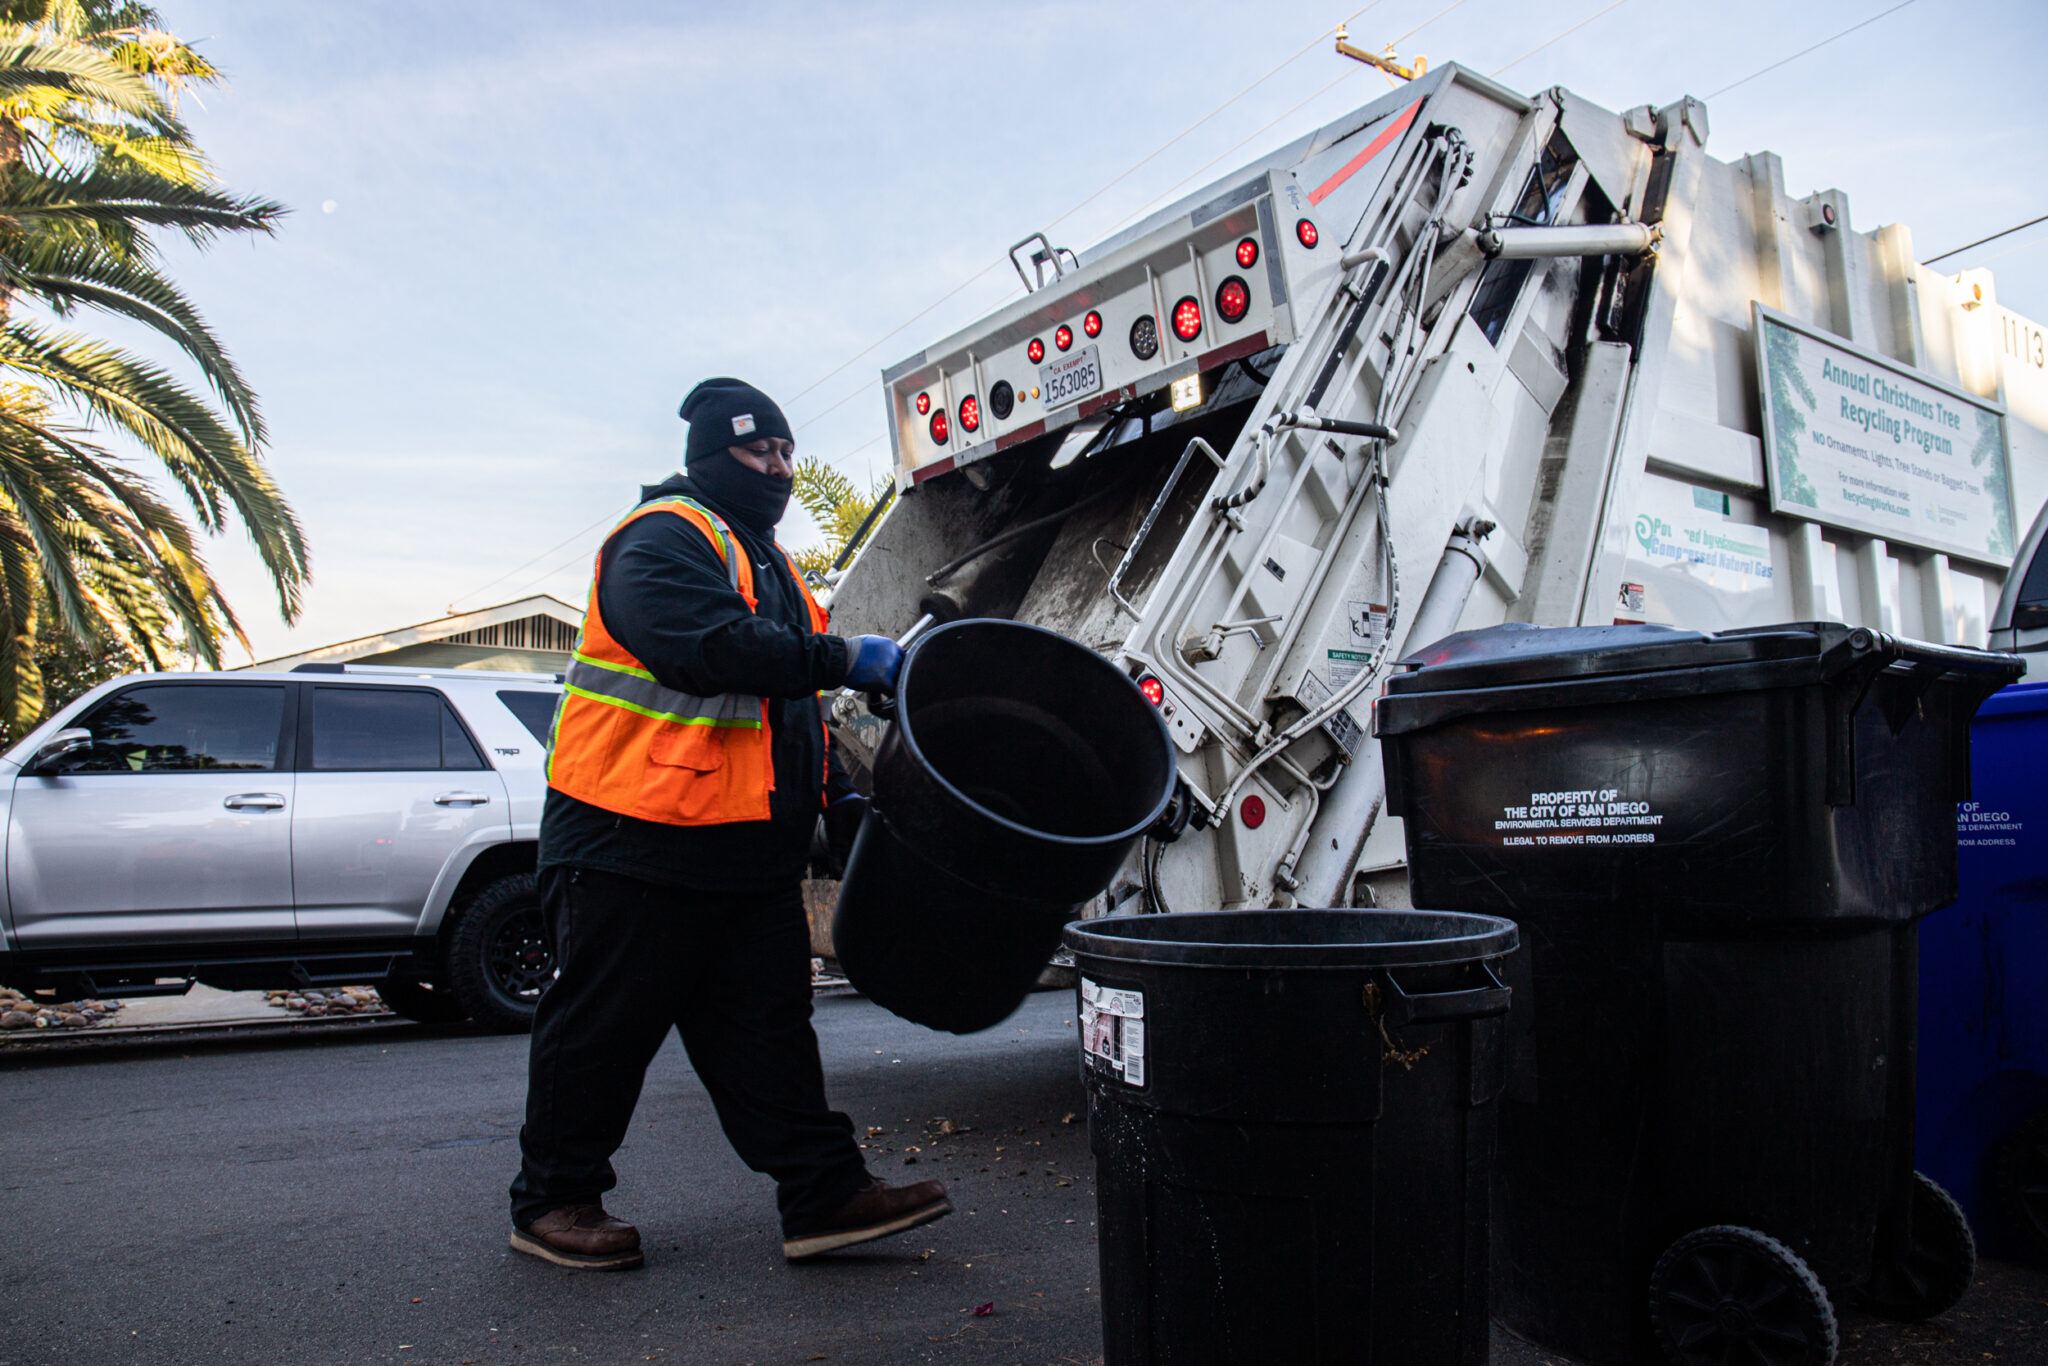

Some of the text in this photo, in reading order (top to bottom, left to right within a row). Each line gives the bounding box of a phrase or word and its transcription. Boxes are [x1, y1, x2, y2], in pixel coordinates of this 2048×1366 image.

[1053, 356, 1084, 375] CA EXEMPT
[1045, 363, 1095, 403] 1563085
[1822, 357, 1961, 431] Annual Christmas Tree
[1840, 395, 1953, 455] Recycling Program
[1812, 430, 1826, 445] NO
[1827, 435, 1871, 462] Ornaments,
[1871, 450, 1895, 470] Lights,
[1895, 458, 1911, 473] Tree
[1720, 553, 1754, 575] Natural
[1755, 561, 1774, 579] Gas
[1332, 651, 1368, 661] SAFETY NOTICE
[1531, 789, 1618, 805] PROPERTY OF
[1504, 801, 1650, 819] THE CITY OF SAN DIEGO
[1963, 802, 1980, 812] OF
[1495, 815, 1663, 830] ENVIRONMENTAL SERVICES DEPARTMENT
[1971, 811, 2010, 822] DIEGO
[1503, 833, 1655, 846] ILLEGAL TO REMOVE FROM ADDRESS
[1976, 838, 2016, 846] ADDRESS
